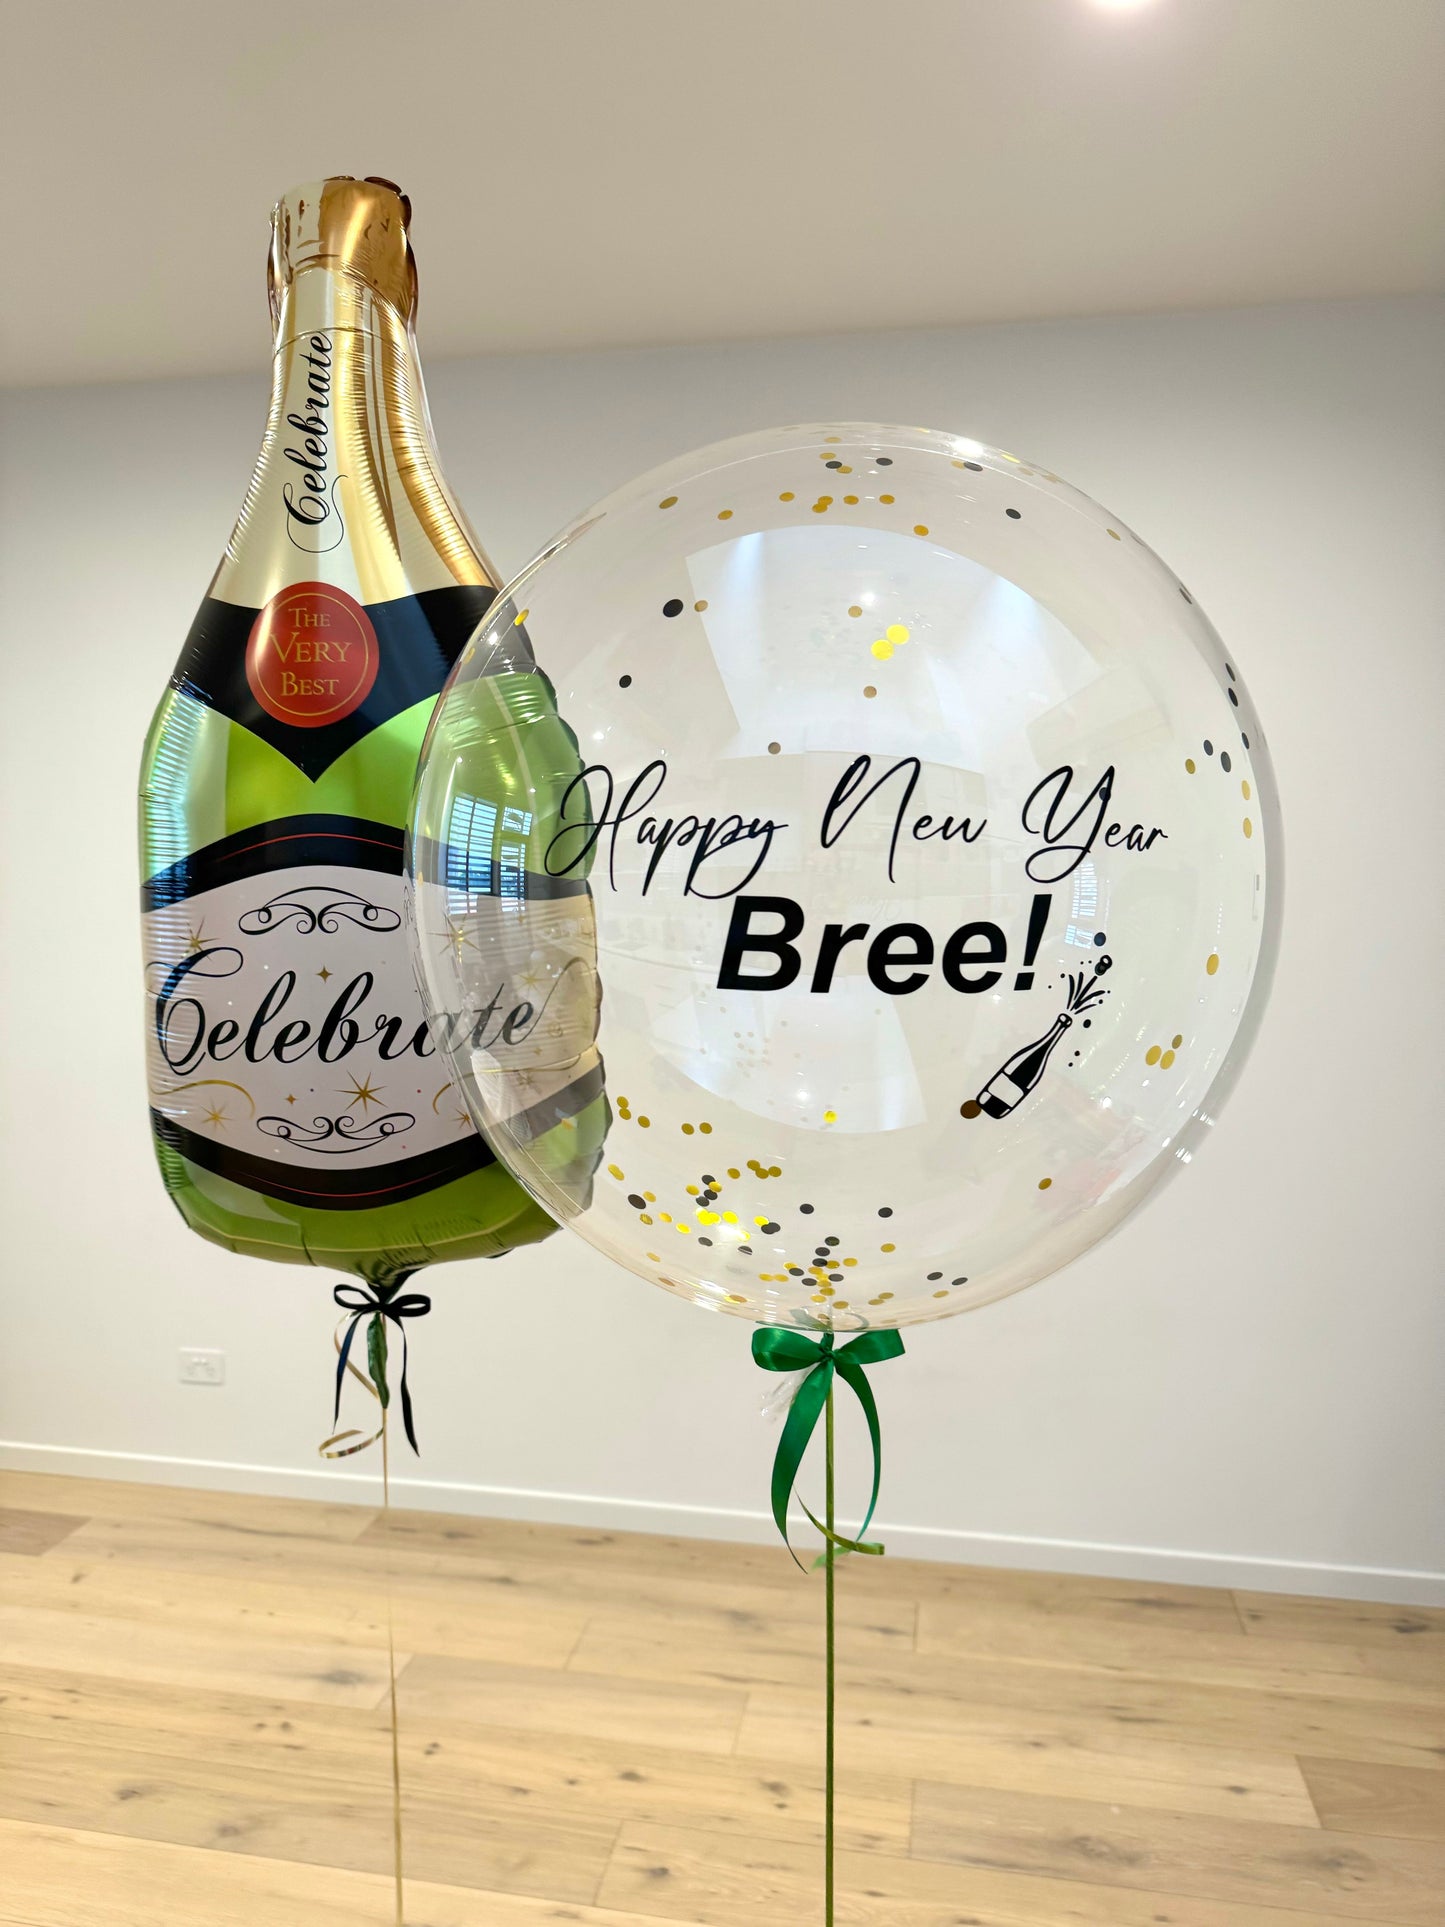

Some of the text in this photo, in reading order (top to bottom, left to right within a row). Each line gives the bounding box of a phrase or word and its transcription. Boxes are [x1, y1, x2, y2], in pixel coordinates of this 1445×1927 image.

[283, 331, 348, 553] Celebrate
[544, 754, 1169, 899] Happy New Year
[146, 947, 592, 1076] Celebrate
[716, 893, 1053, 995] Bree!
